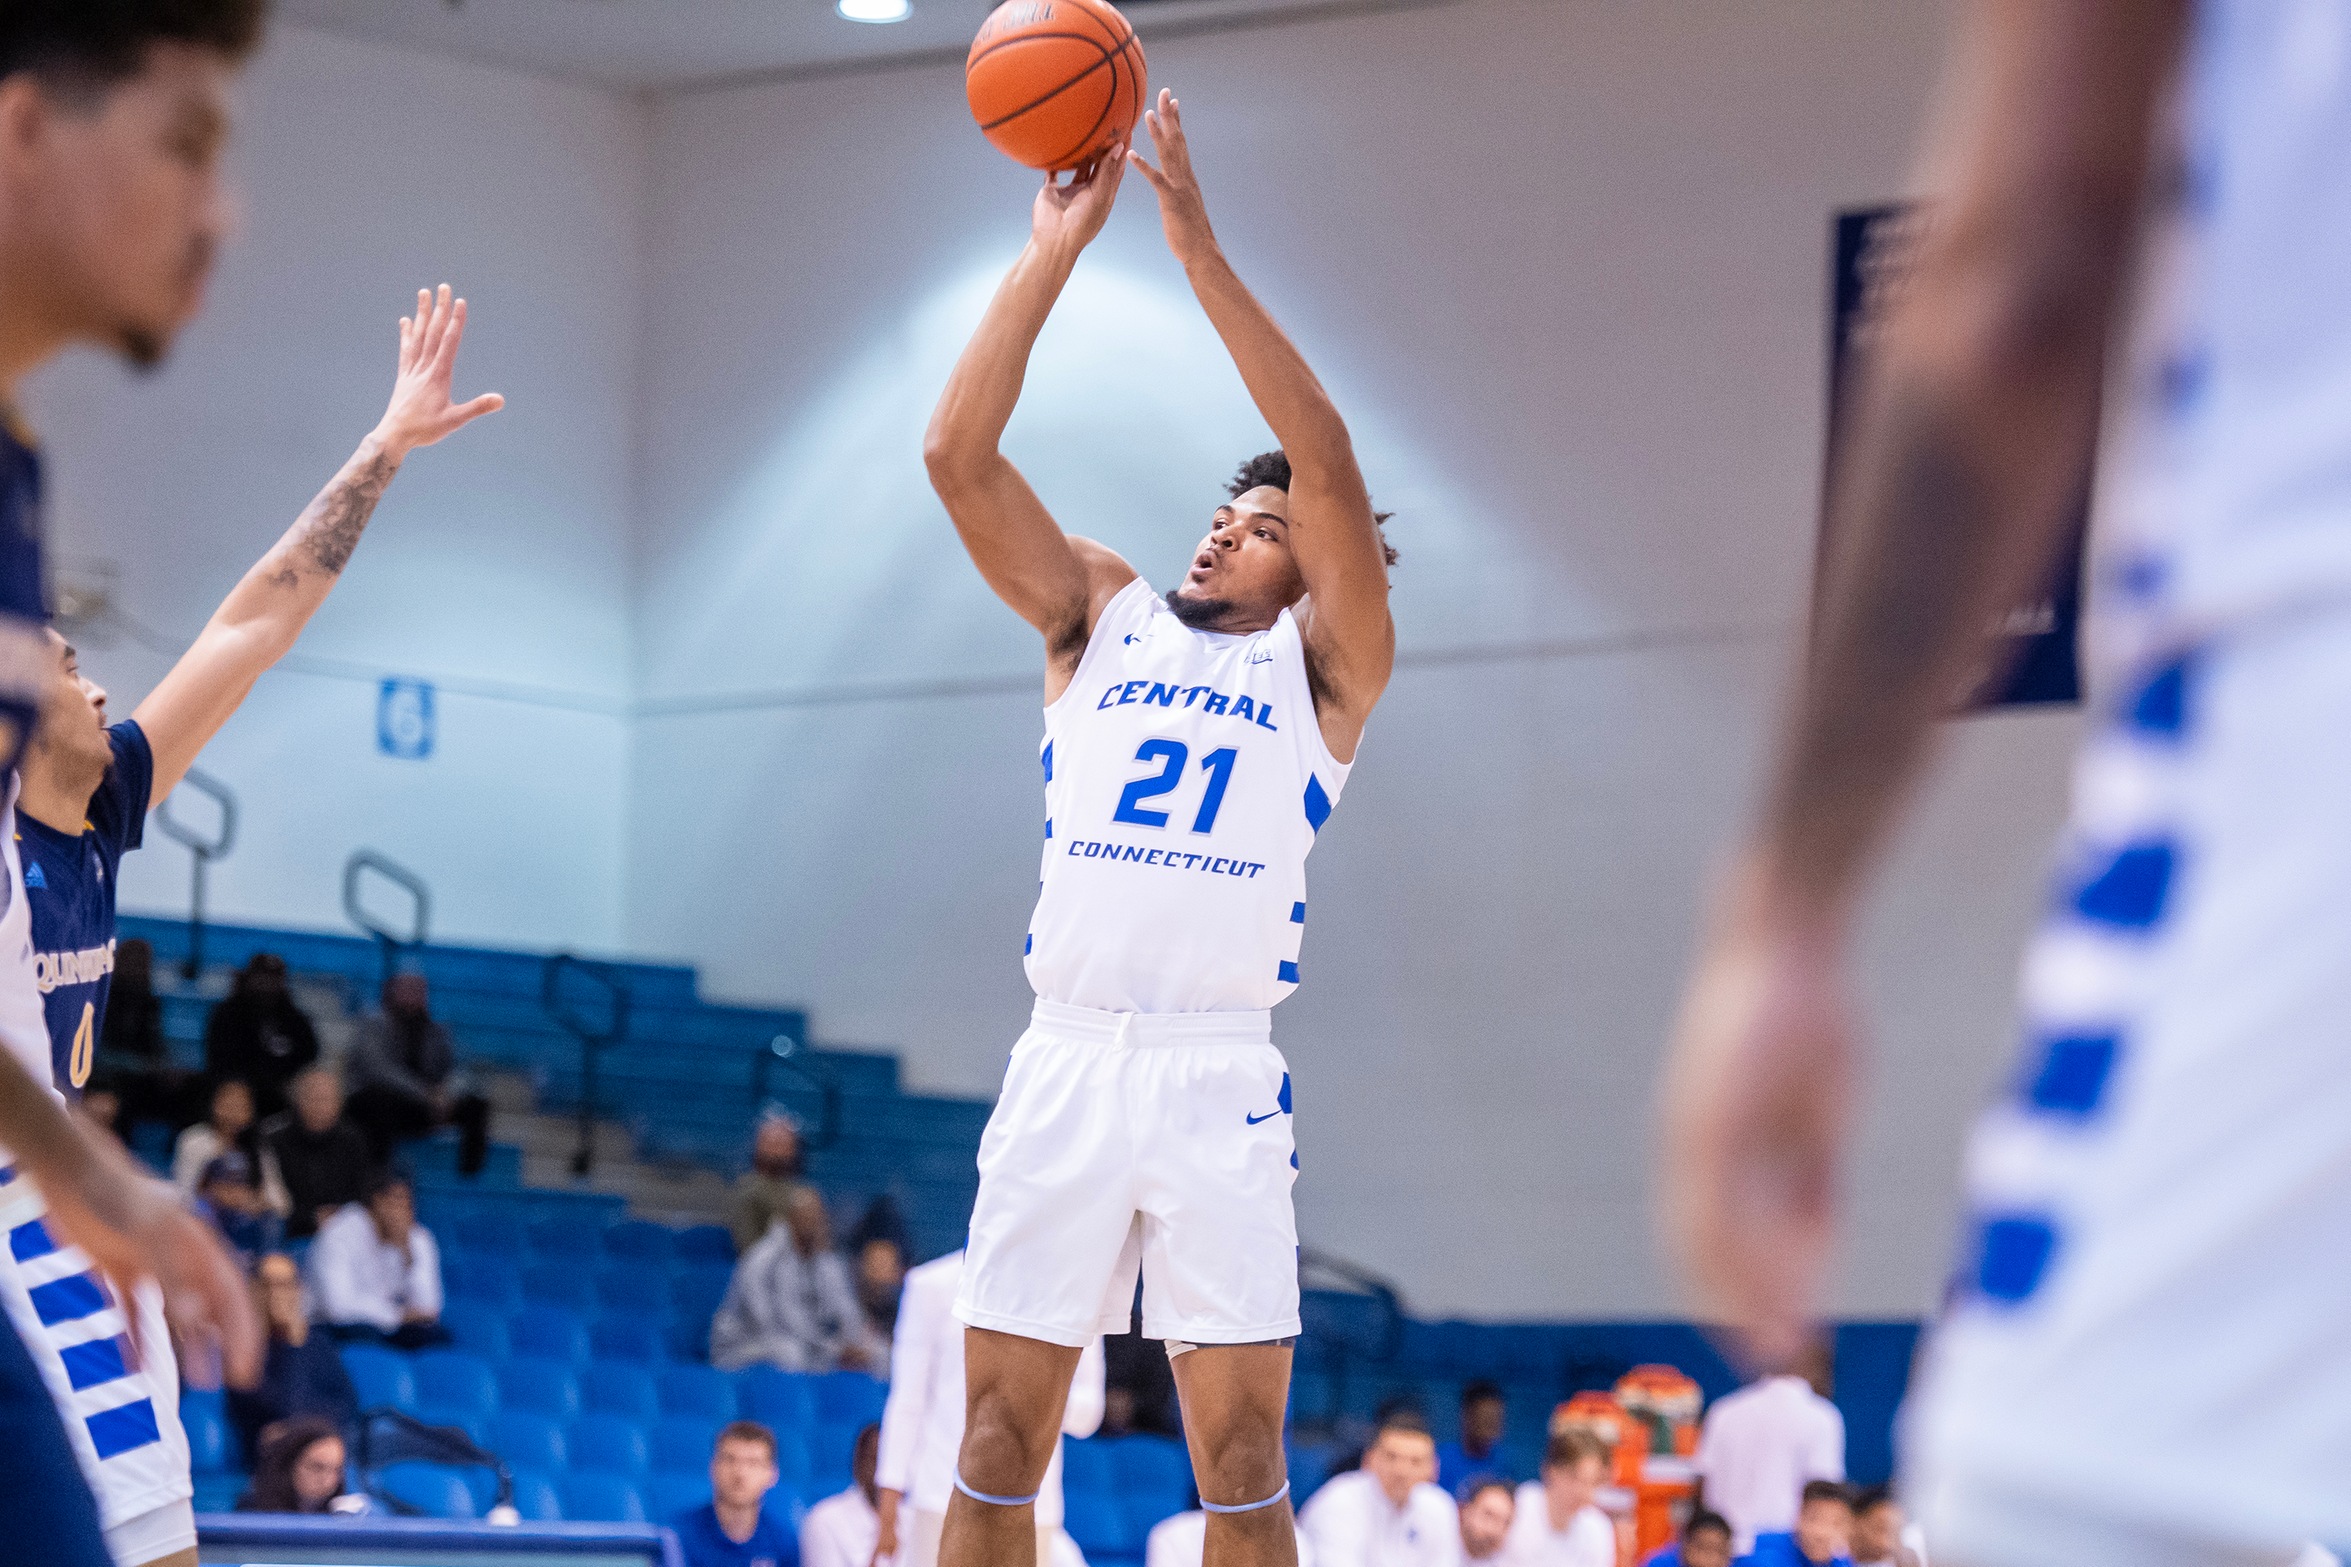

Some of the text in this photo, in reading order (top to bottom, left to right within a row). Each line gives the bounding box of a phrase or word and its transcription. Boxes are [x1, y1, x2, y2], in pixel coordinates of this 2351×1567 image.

[1097, 680, 1277, 732] CENTRAL
[1110, 736, 1239, 837] 21
[1068, 840, 1266, 879] CONNECTICUT
[69, 1001, 94, 1089] 0
